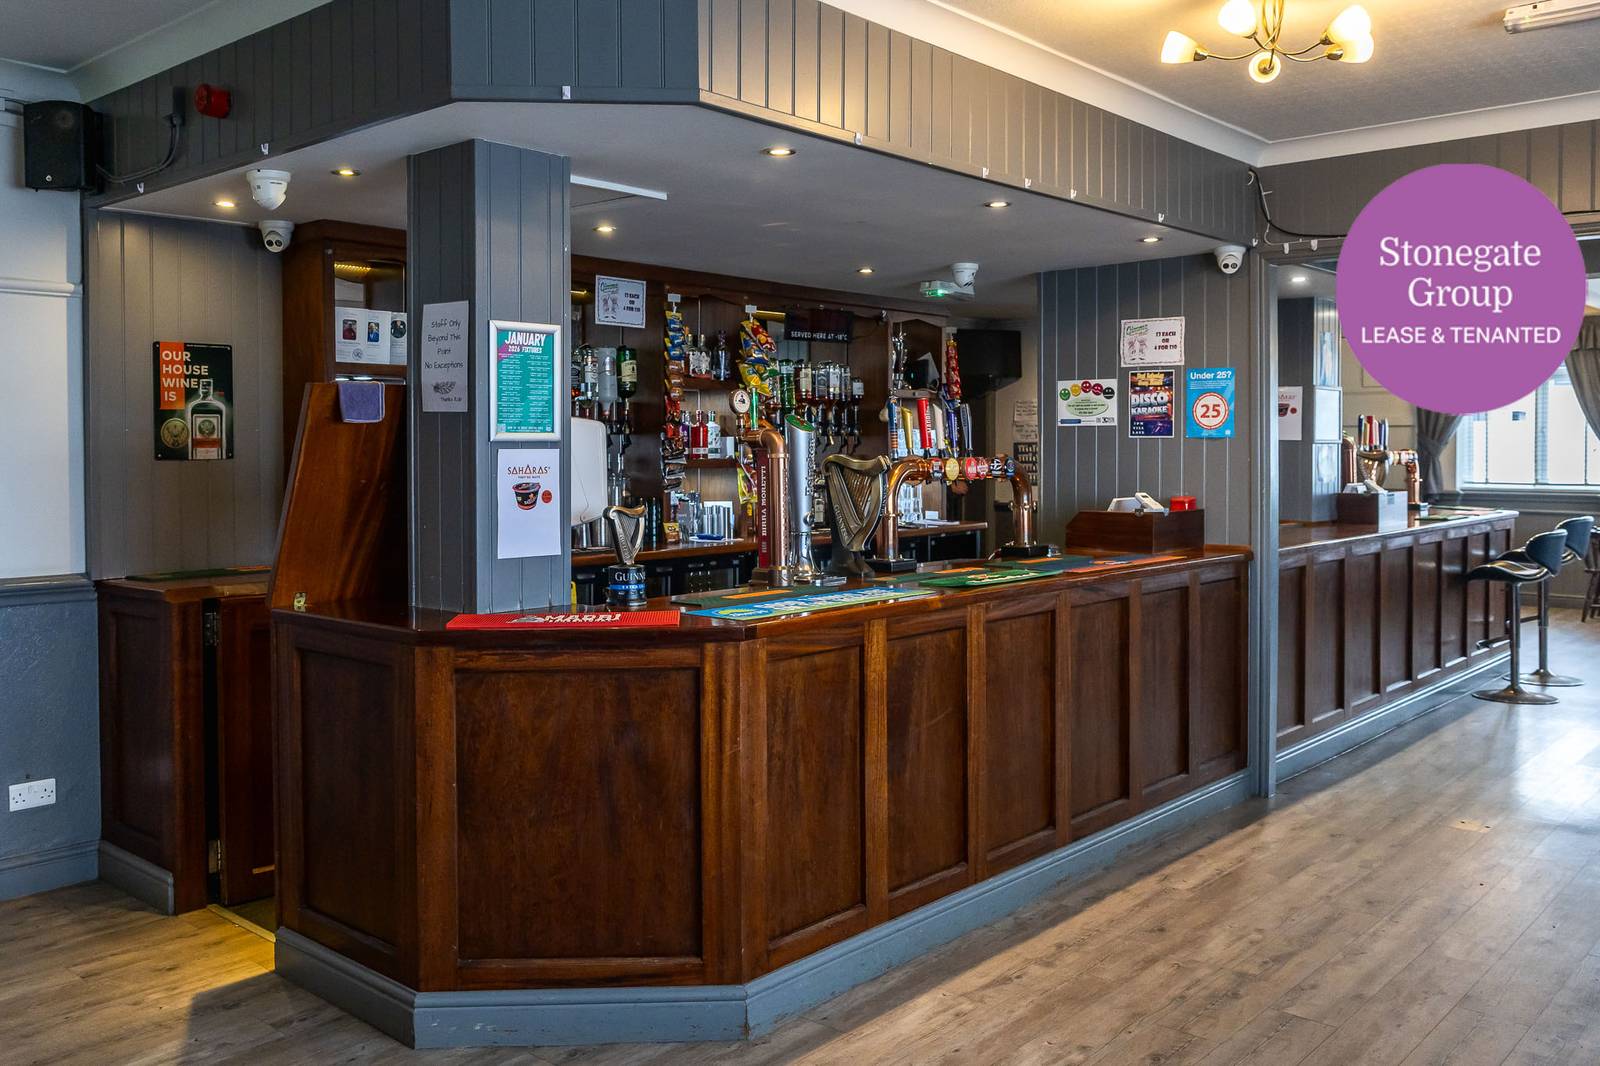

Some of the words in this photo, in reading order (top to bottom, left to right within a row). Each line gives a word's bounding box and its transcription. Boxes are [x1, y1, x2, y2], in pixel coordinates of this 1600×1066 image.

[431, 318, 448, 328] Staff
[449, 320, 461, 330] Only
[427, 333, 449, 345] Beyond
[504, 331, 546, 346] JANUARY
[521, 346, 543, 354] FIXTURES
[161, 350, 192, 362] OUR
[162, 365, 209, 376] HOUSE
[434, 361, 464, 372] Exceptions
[1190, 371, 1215, 380] Under
[1216, 370, 1232, 379] 25?
[162, 378, 199, 389] WINE
[164, 391, 177, 401] IS
[1131, 392, 1169, 406] DISCO
[1131, 405, 1169, 415] KARAOKE
[1200, 403, 1221, 419] 25
[507, 464, 548, 475] SAHARAS
